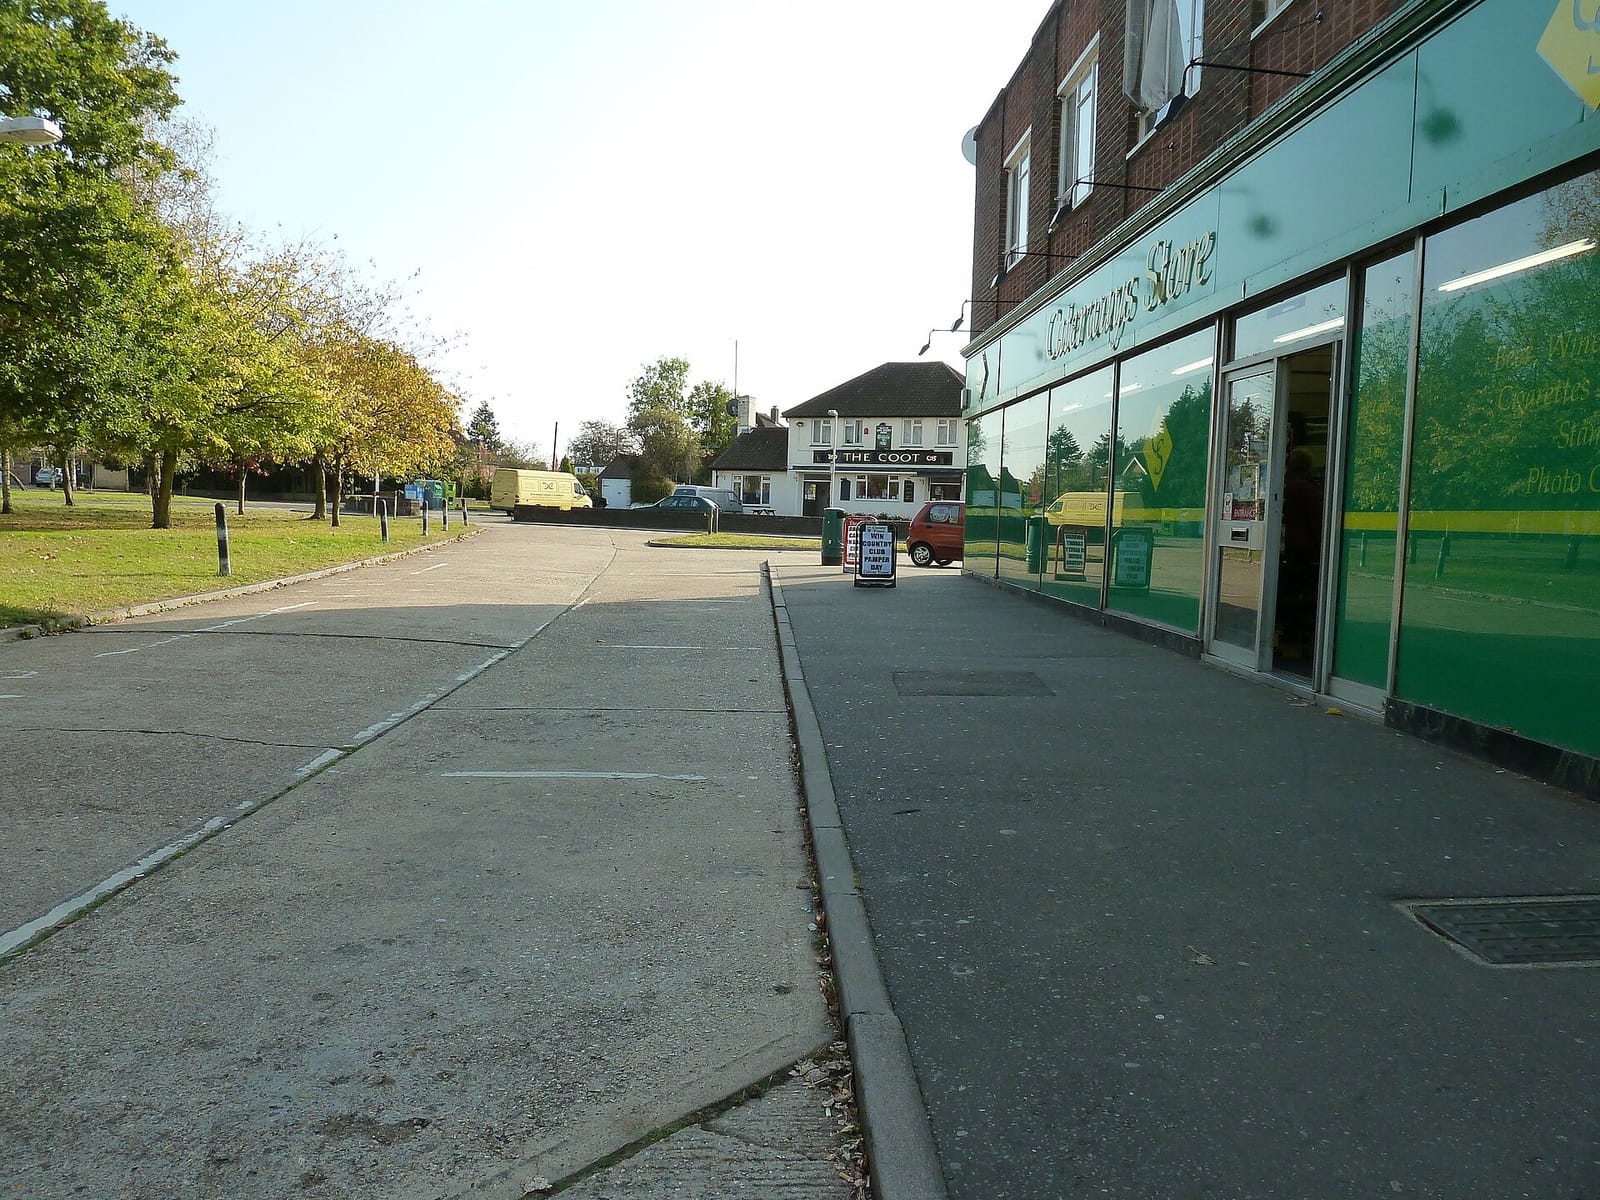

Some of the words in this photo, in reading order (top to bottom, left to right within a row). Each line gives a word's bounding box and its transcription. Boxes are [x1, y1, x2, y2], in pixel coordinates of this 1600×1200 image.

[1143, 230, 1217, 313] Store
[843, 452, 871, 462] THE
[878, 453, 920, 463] COOT
[1525, 465, 1581, 495] Photo
[862, 540, 891, 548] COUNTRY
